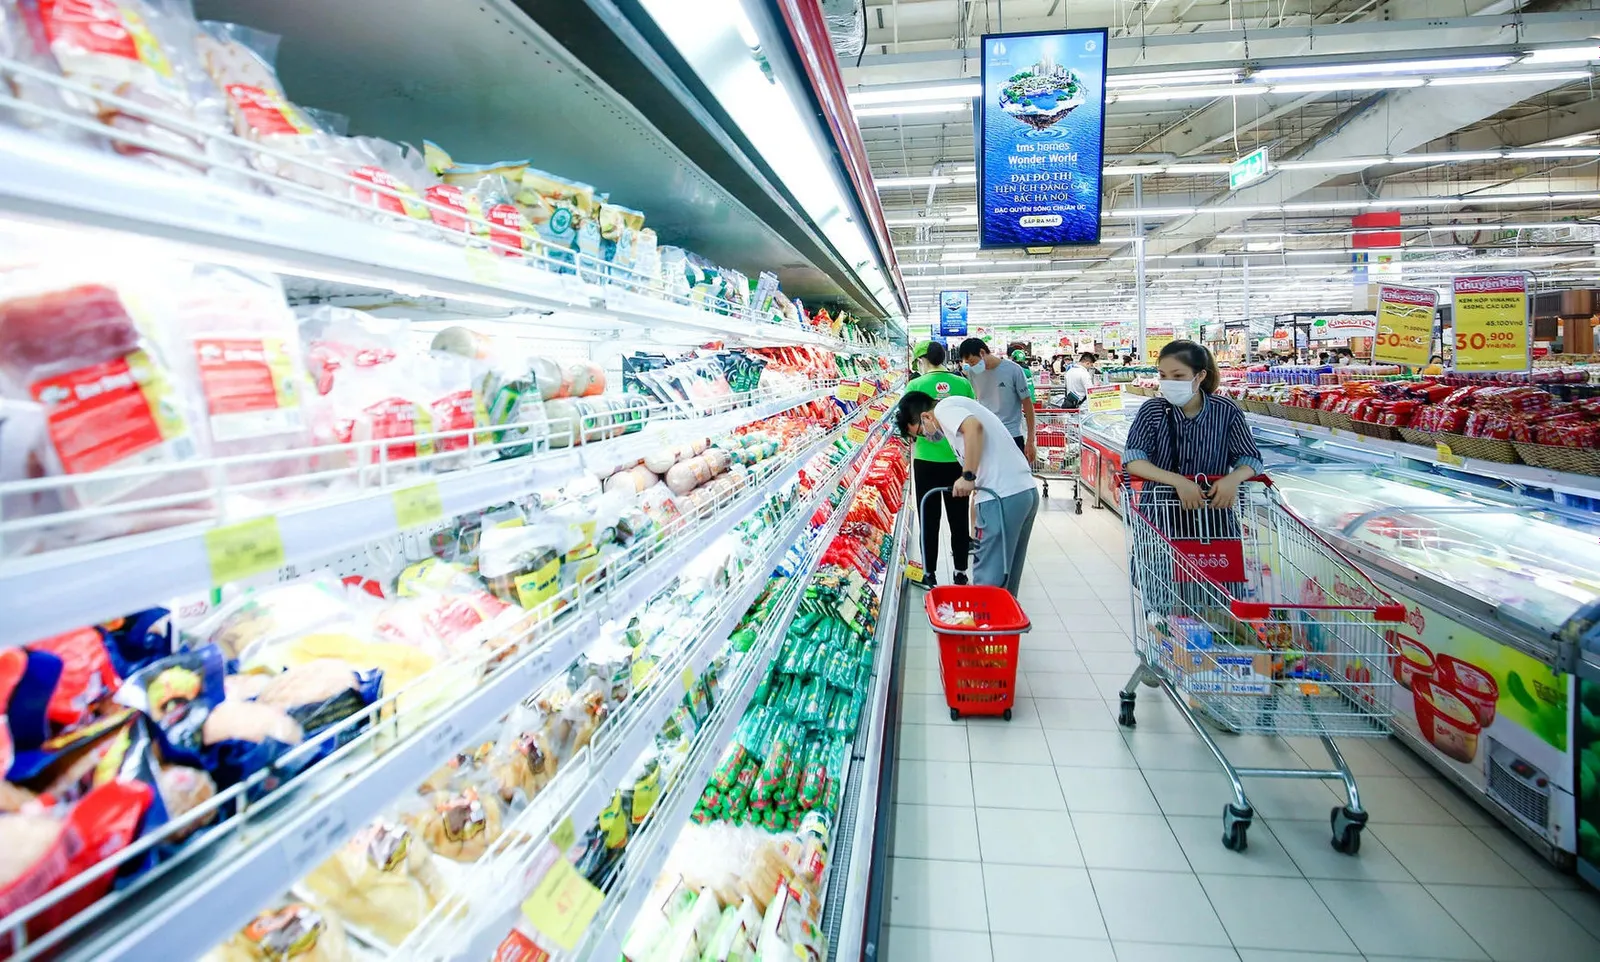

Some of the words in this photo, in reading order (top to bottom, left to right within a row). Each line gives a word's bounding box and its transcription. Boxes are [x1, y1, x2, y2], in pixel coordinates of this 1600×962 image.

[1016, 143, 1034, 152] tms
[1036, 142, 1070, 152] homes
[1008, 154, 1046, 165] Wonder
[1048, 152, 1078, 163] World
